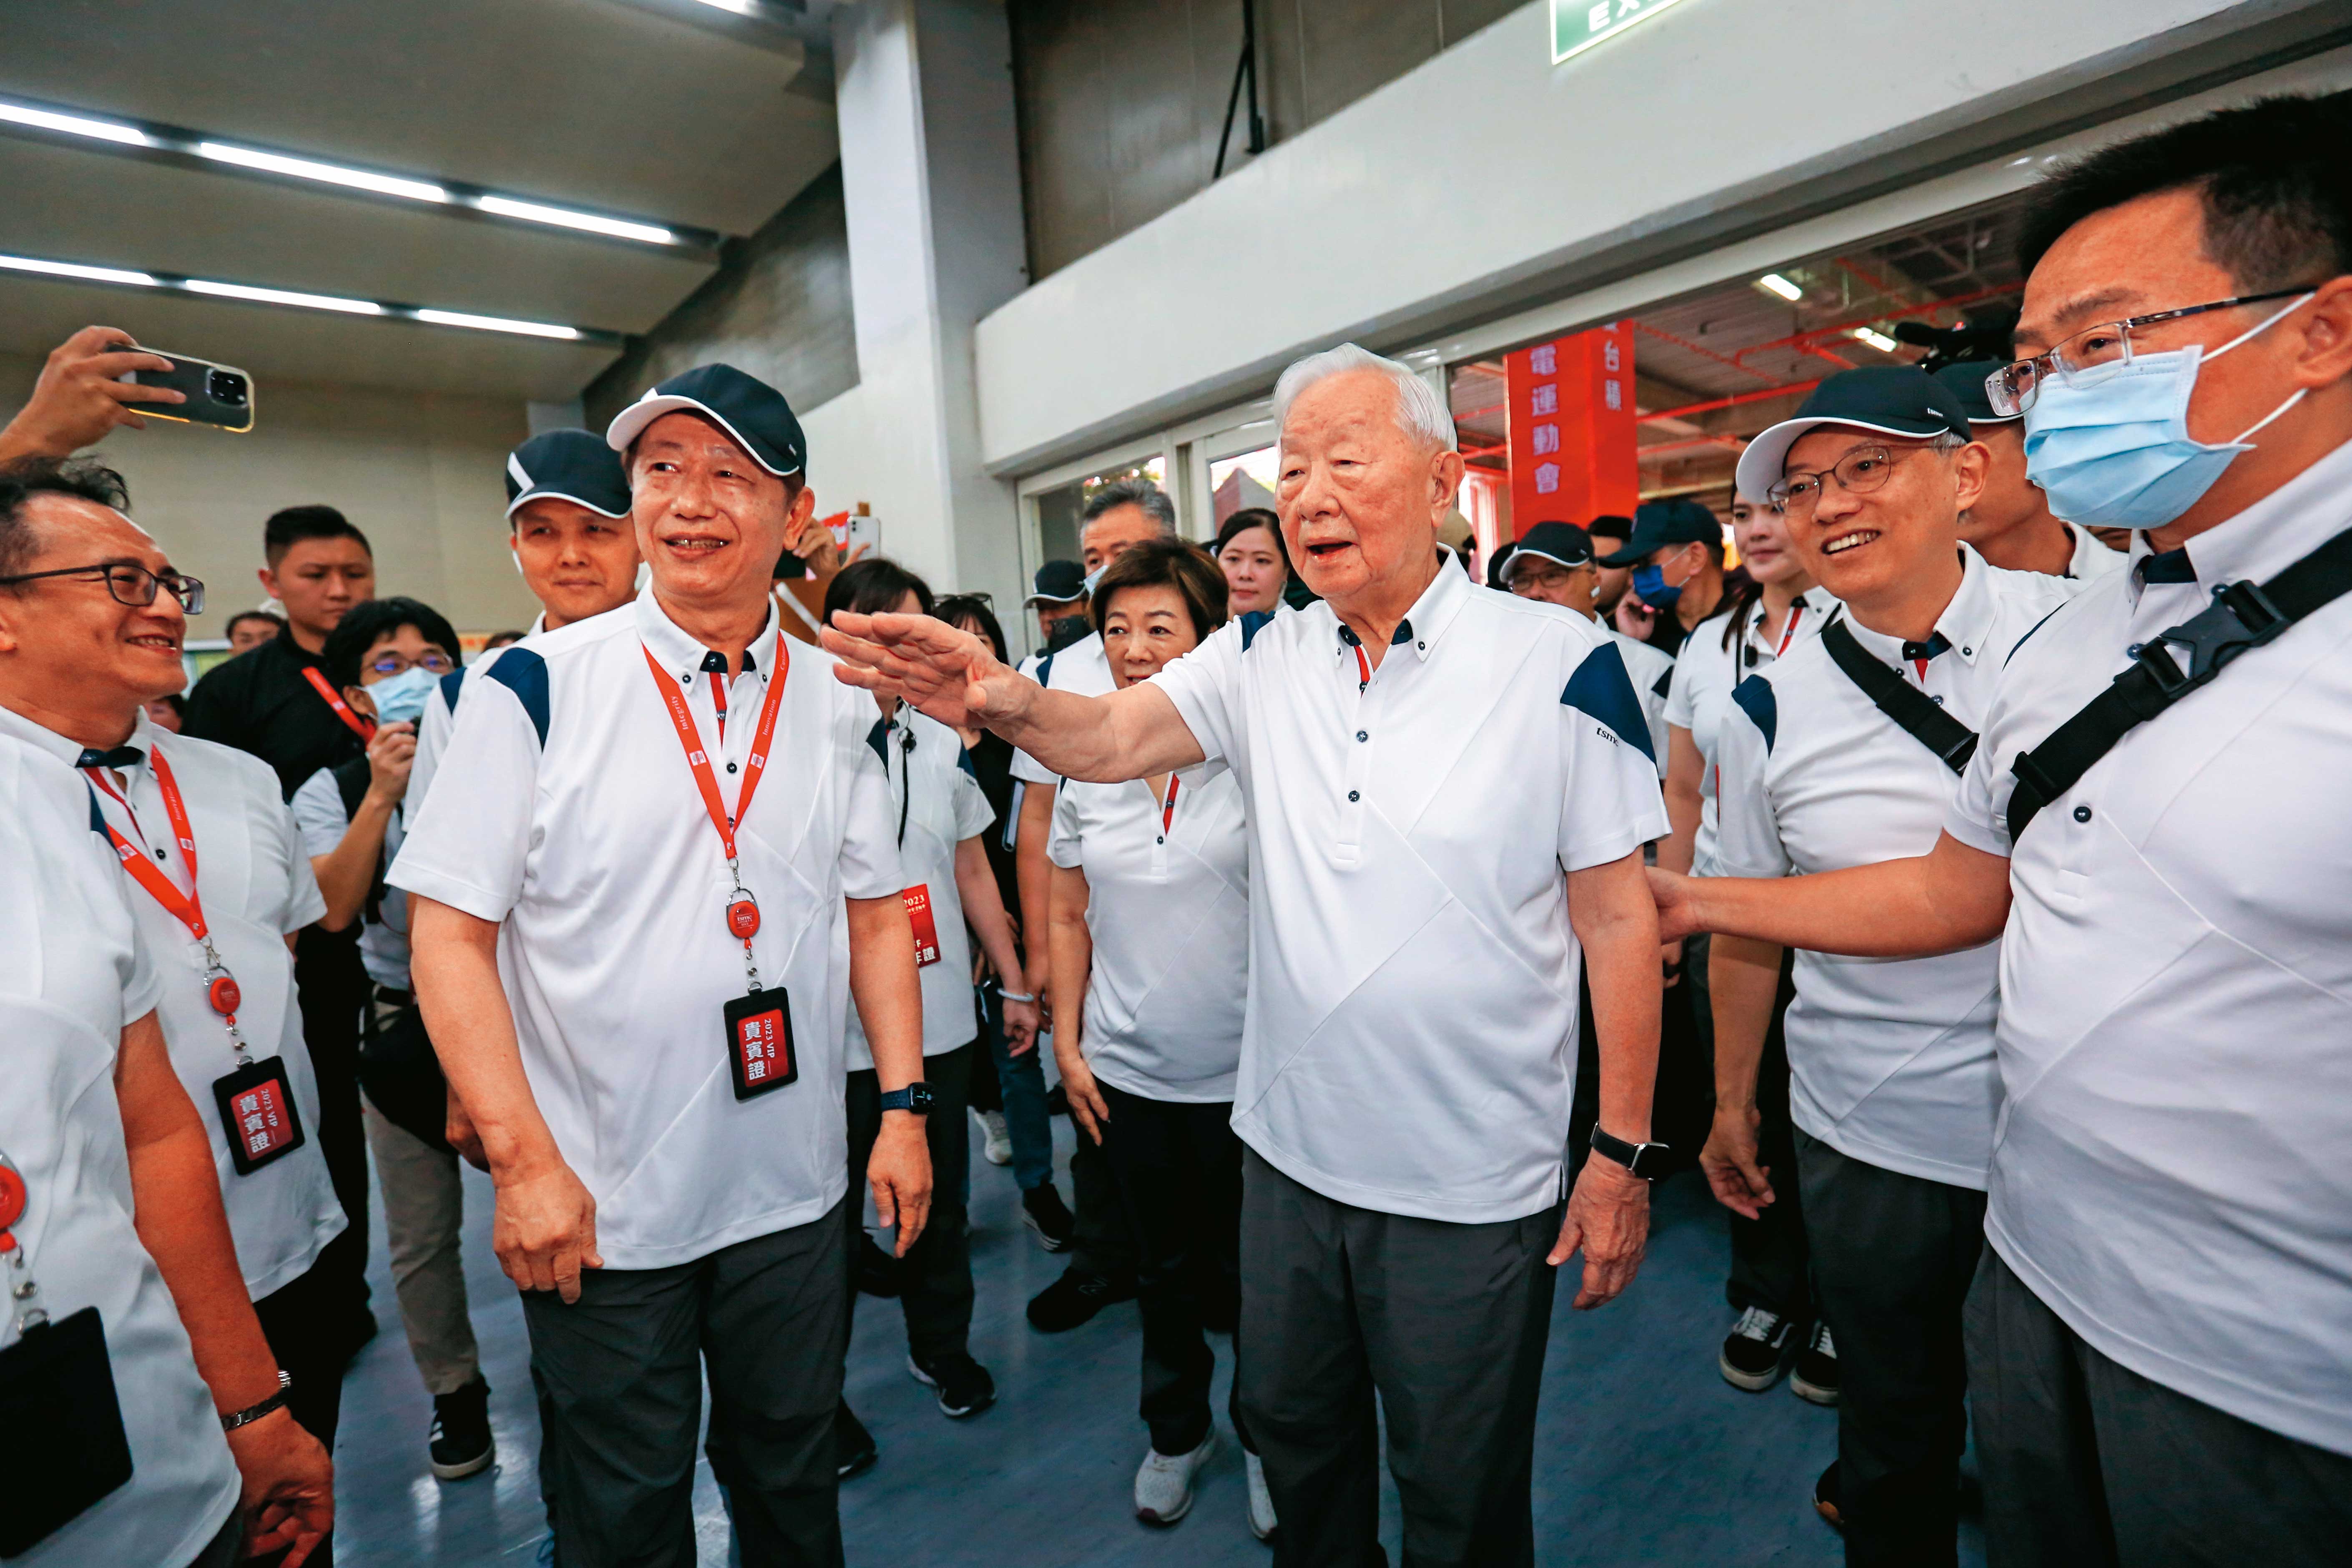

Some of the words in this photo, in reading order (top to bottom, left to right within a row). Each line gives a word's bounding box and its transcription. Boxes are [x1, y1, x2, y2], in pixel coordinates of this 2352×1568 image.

[1603, 323, 1622, 412] 台積
[1530, 344, 1560, 495] 電運動會
[671, 696, 689, 730] Integrity
[762, 699, 776, 736] Innovation
[1596, 727, 1619, 746] tsmc
[764, 1018, 773, 1040] 2023
[744, 1021, 766, 1081] 貴賓證
[766, 1043, 775, 1058] VIP
[261, 1088, 274, 1111] 2023
[239, 1094, 271, 1153] 貴賓證
[267, 1111, 278, 1126] VIP
